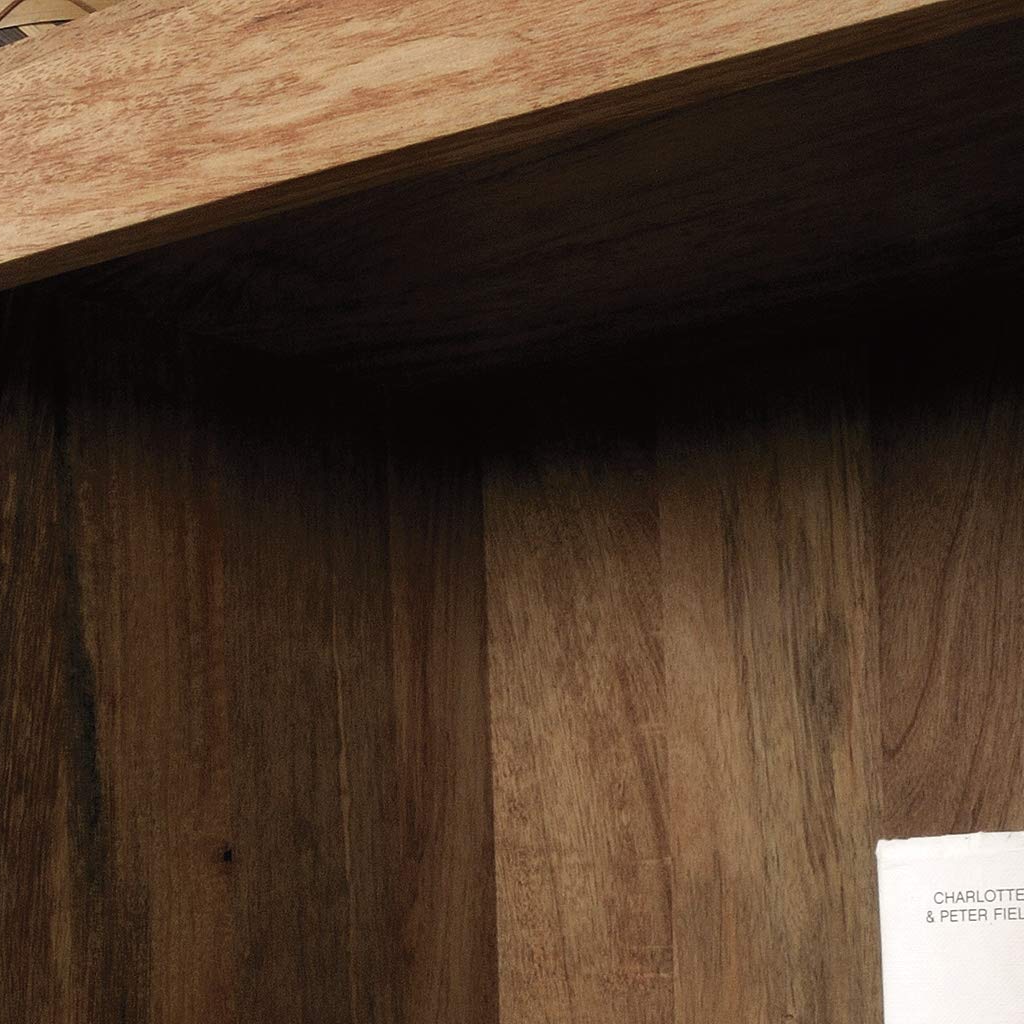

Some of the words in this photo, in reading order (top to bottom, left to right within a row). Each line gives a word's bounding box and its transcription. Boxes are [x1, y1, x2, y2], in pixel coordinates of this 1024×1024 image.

[933, 888, 1024, 905] CHARLOTTE
[926, 910, 935, 923] &
[940, 908, 988, 922] PETER
